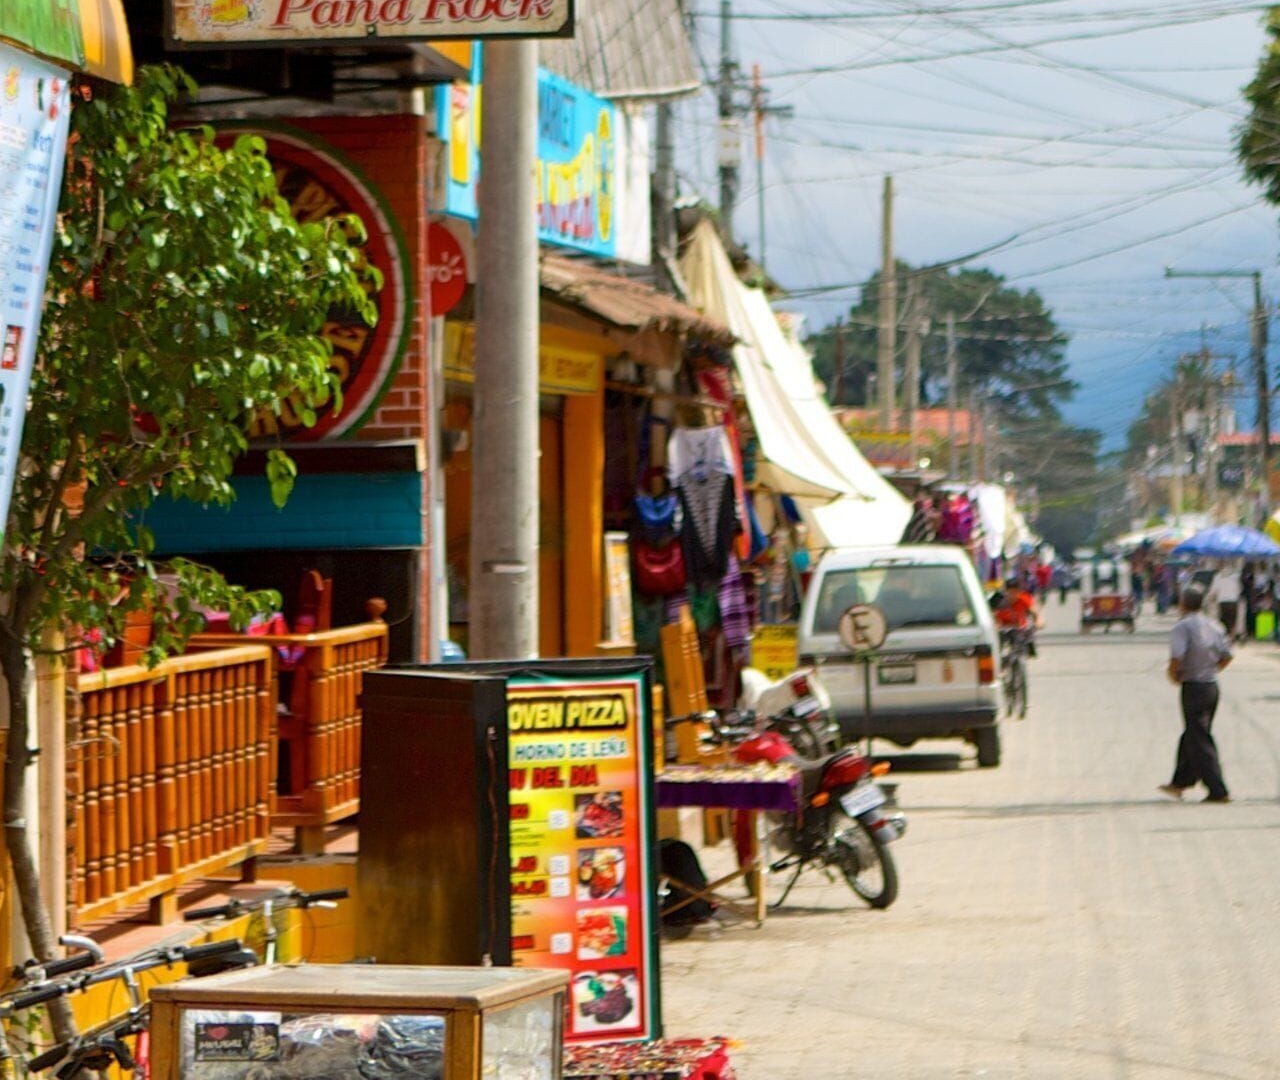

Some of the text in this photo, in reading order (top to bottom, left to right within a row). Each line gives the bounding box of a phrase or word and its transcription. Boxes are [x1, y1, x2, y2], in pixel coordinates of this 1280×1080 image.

[508, 697, 627, 731] OVEN PIZZA
[515, 738, 626, 761] HORNO DE LEÑA
[531, 765, 564, 789] DEL
[569, 763, 599, 788] DIA
